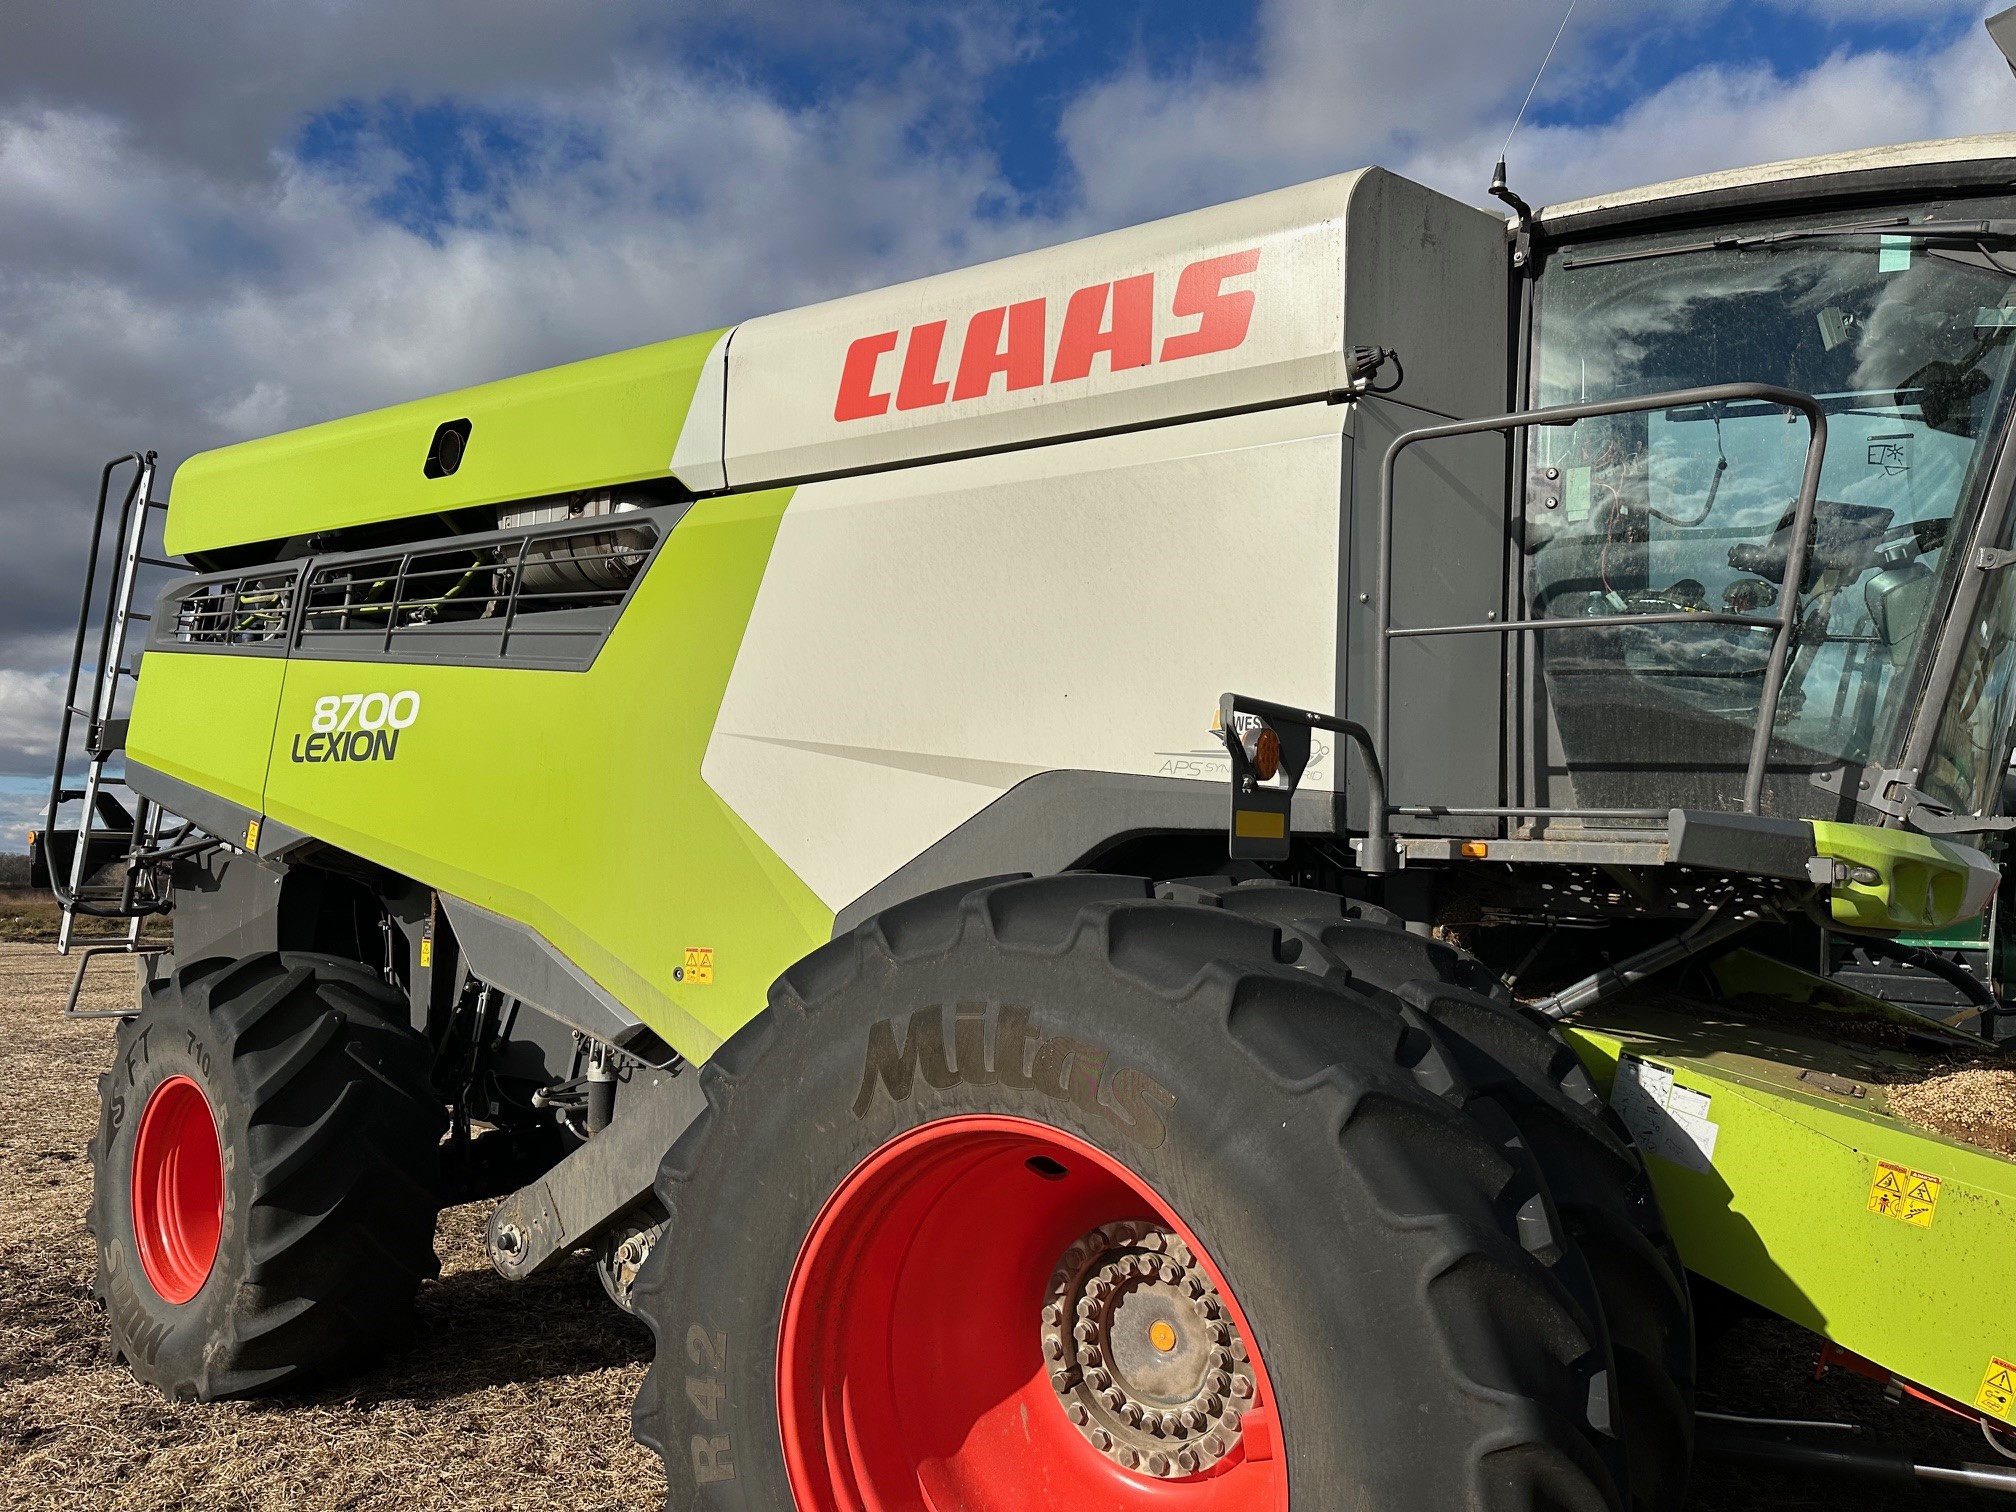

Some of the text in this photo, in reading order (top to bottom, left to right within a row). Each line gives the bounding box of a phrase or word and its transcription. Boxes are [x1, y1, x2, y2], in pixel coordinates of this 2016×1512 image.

[834, 247, 1262, 422] CLAAS
[311, 690, 420, 732] 8700
[291, 729, 400, 762] LEXION
[1158, 759, 1204, 776] APS
[852, 1001, 1180, 1149] Mitas
